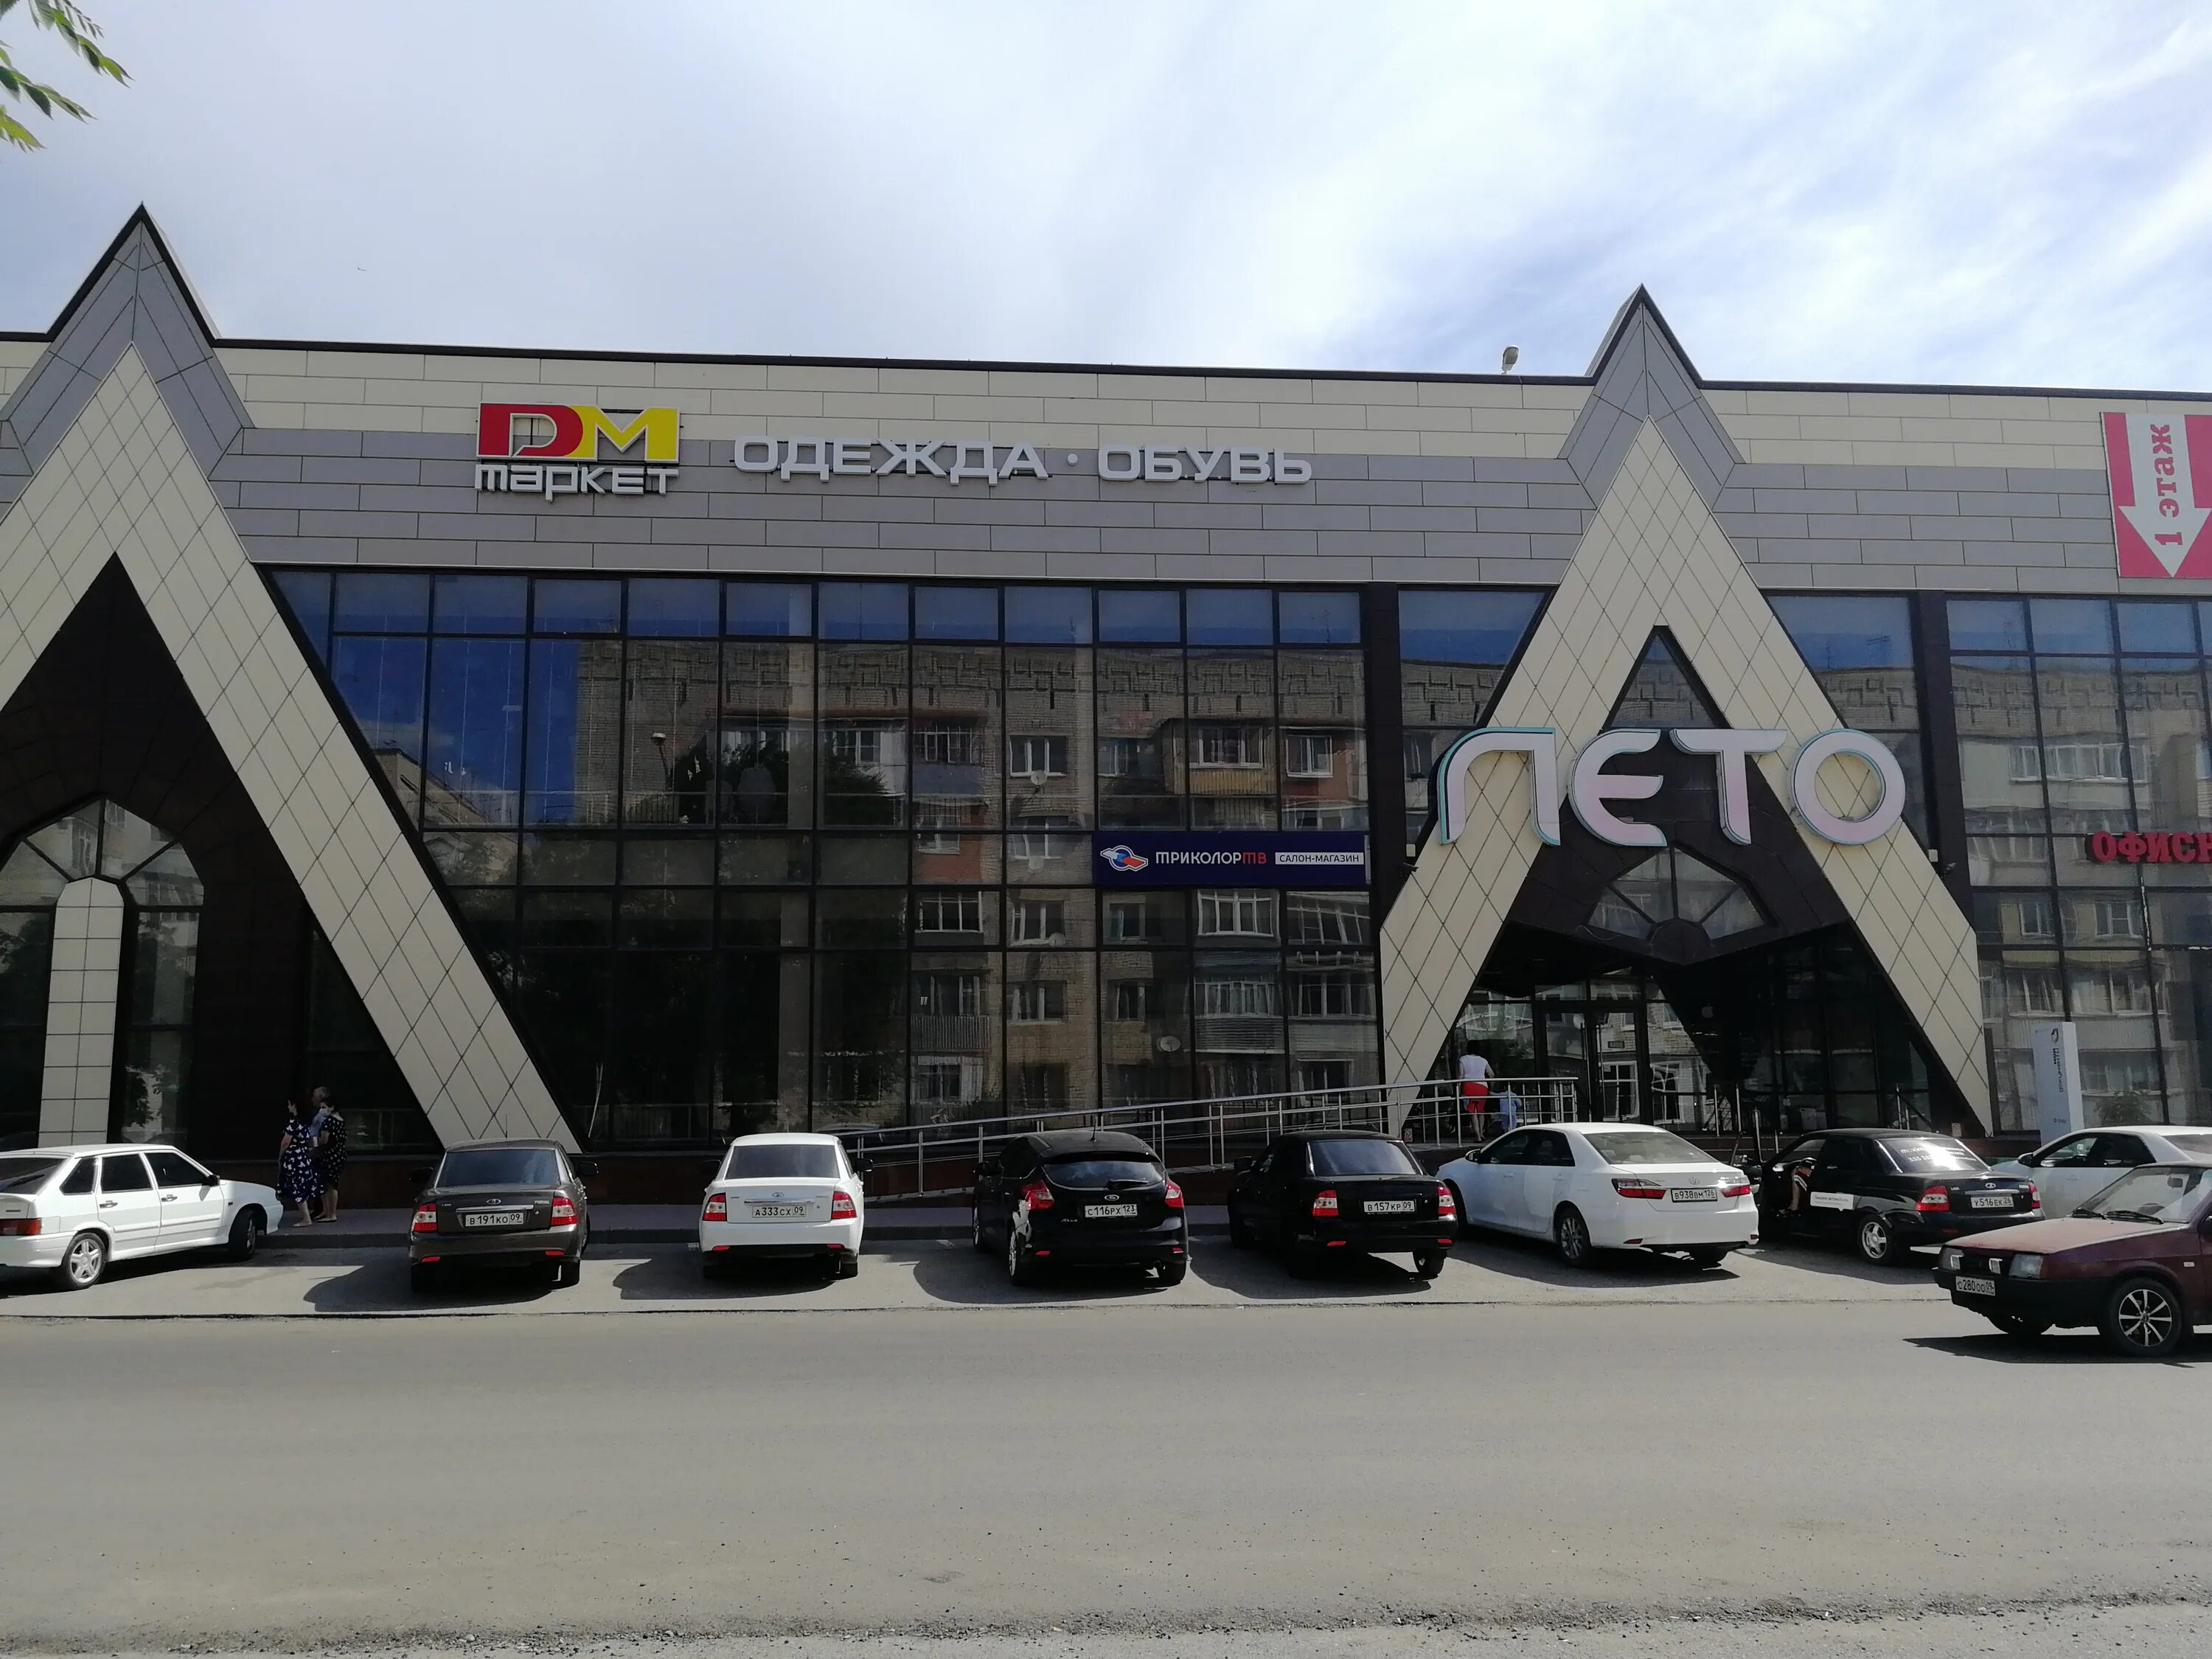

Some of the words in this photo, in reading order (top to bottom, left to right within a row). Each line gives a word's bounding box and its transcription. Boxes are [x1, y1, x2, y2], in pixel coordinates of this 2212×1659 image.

[734, 435, 1050, 487] ОДЕЖДА
[1097, 444, 1312, 485] ОБУВЬ
[2150, 424, 2180, 518] этаж
[2154, 532, 2183, 546] 1
[1434, 726, 1906, 846] ЛЕТО
[1279, 854, 1360, 863] САЛОН-МАГАЗИН
